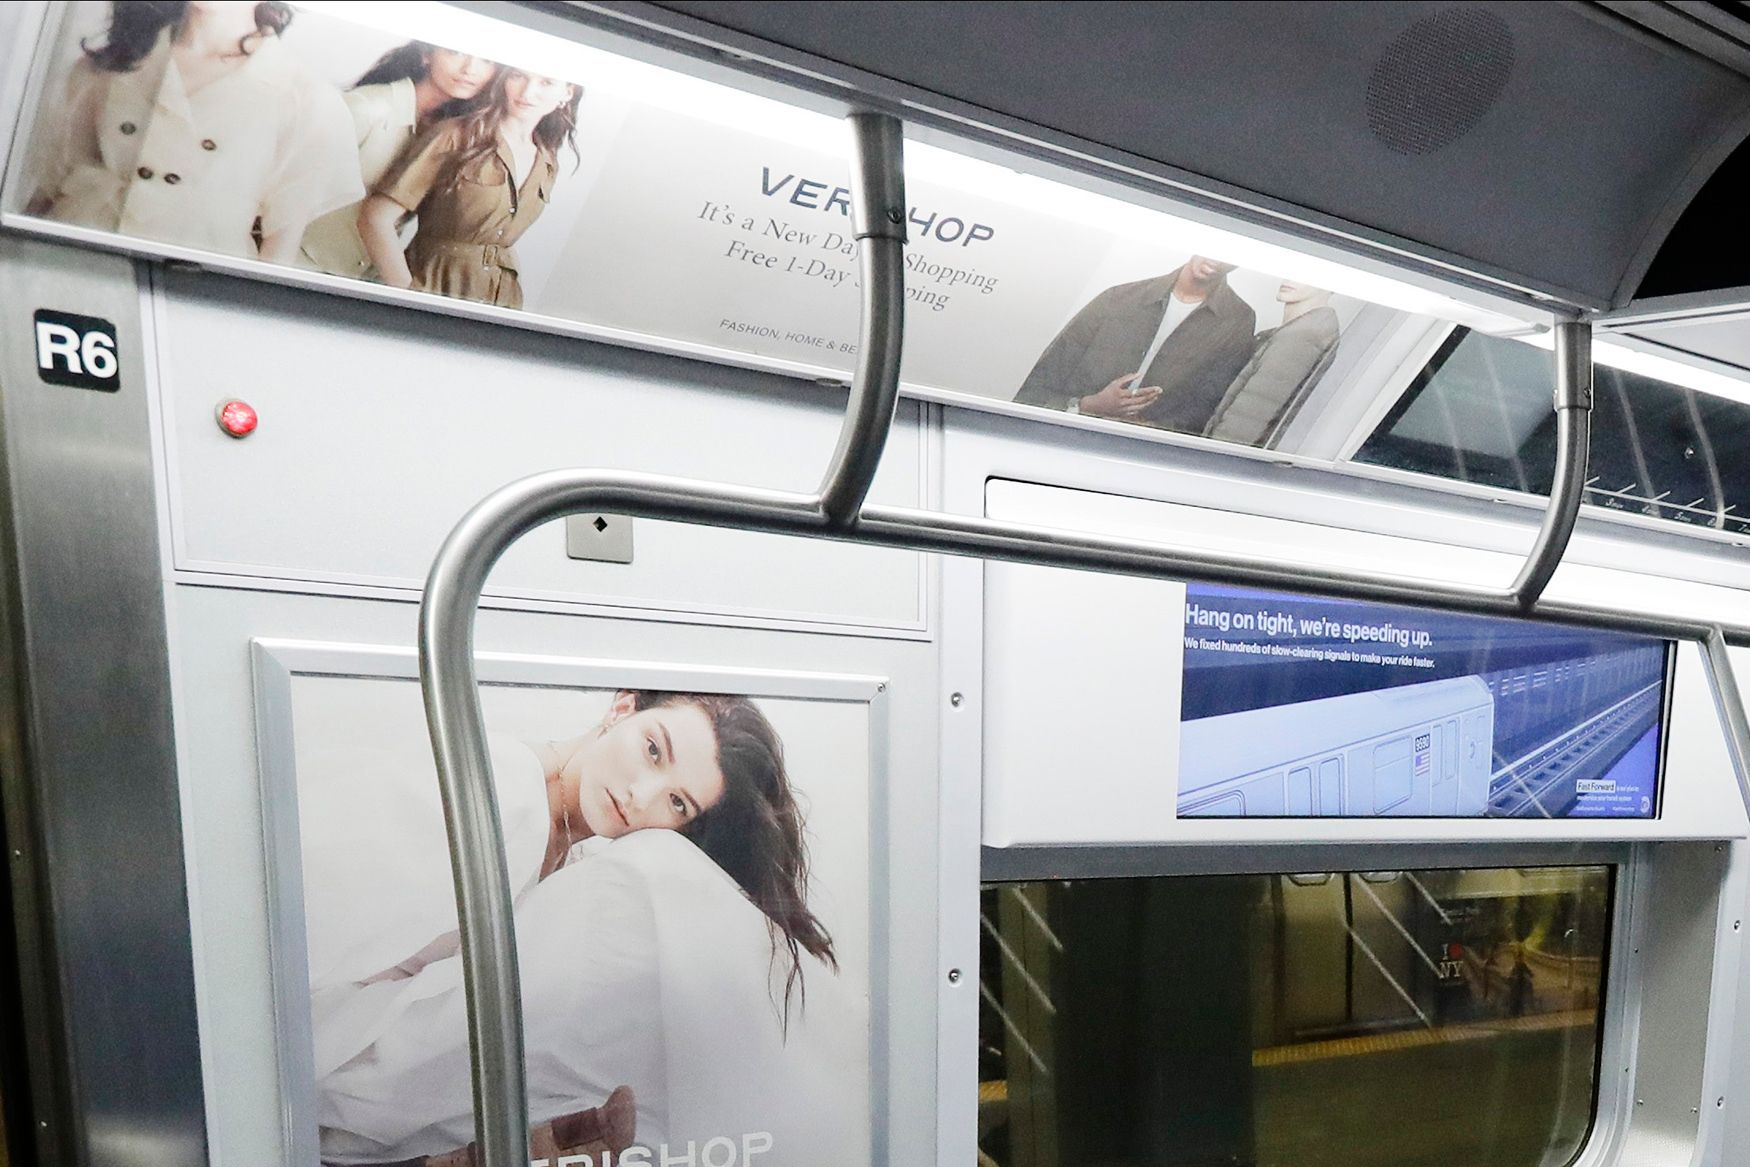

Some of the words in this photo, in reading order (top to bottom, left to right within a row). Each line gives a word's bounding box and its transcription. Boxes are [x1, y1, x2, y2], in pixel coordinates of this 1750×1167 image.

[760, 166, 995, 247] VERHOP
[724, 240, 778, 268] Free
[785, 256, 851, 288] 1-Day
[742, 216, 755, 231] a
[762, 218, 818, 245] New
[905, 253, 999, 295] Shopping
[36, 321, 118, 379] R6
[720, 318, 781, 340] FASHION,
[785, 331, 825, 348] HOME
[826, 340, 835, 350] &
[1185, 603, 1230, 631] Hang
[1233, 611, 1254, 629] on
[1257, 614, 1297, 637] tight,
[1300, 617, 1340, 638] we're
[1343, 623, 1409, 648] speeding
[1412, 631, 1433, 649] up.
[1184, 637, 1198, 649] We
[1200, 638, 1220, 650] fixed
[1221, 640, 1261, 654] hundreds
[1261, 645, 1271, 655] of
[1271, 645, 1323, 661] slow-clearing
[1324, 649, 1351, 662] signals
[1351, 652, 1360, 662] to
[1360, 653, 1381, 664] make
[1381, 656, 1399, 666] your
[1399, 656, 1412, 666] ride
[1413, 656, 1435, 668] faster.
[1591, 782, 1615, 791] Forward
